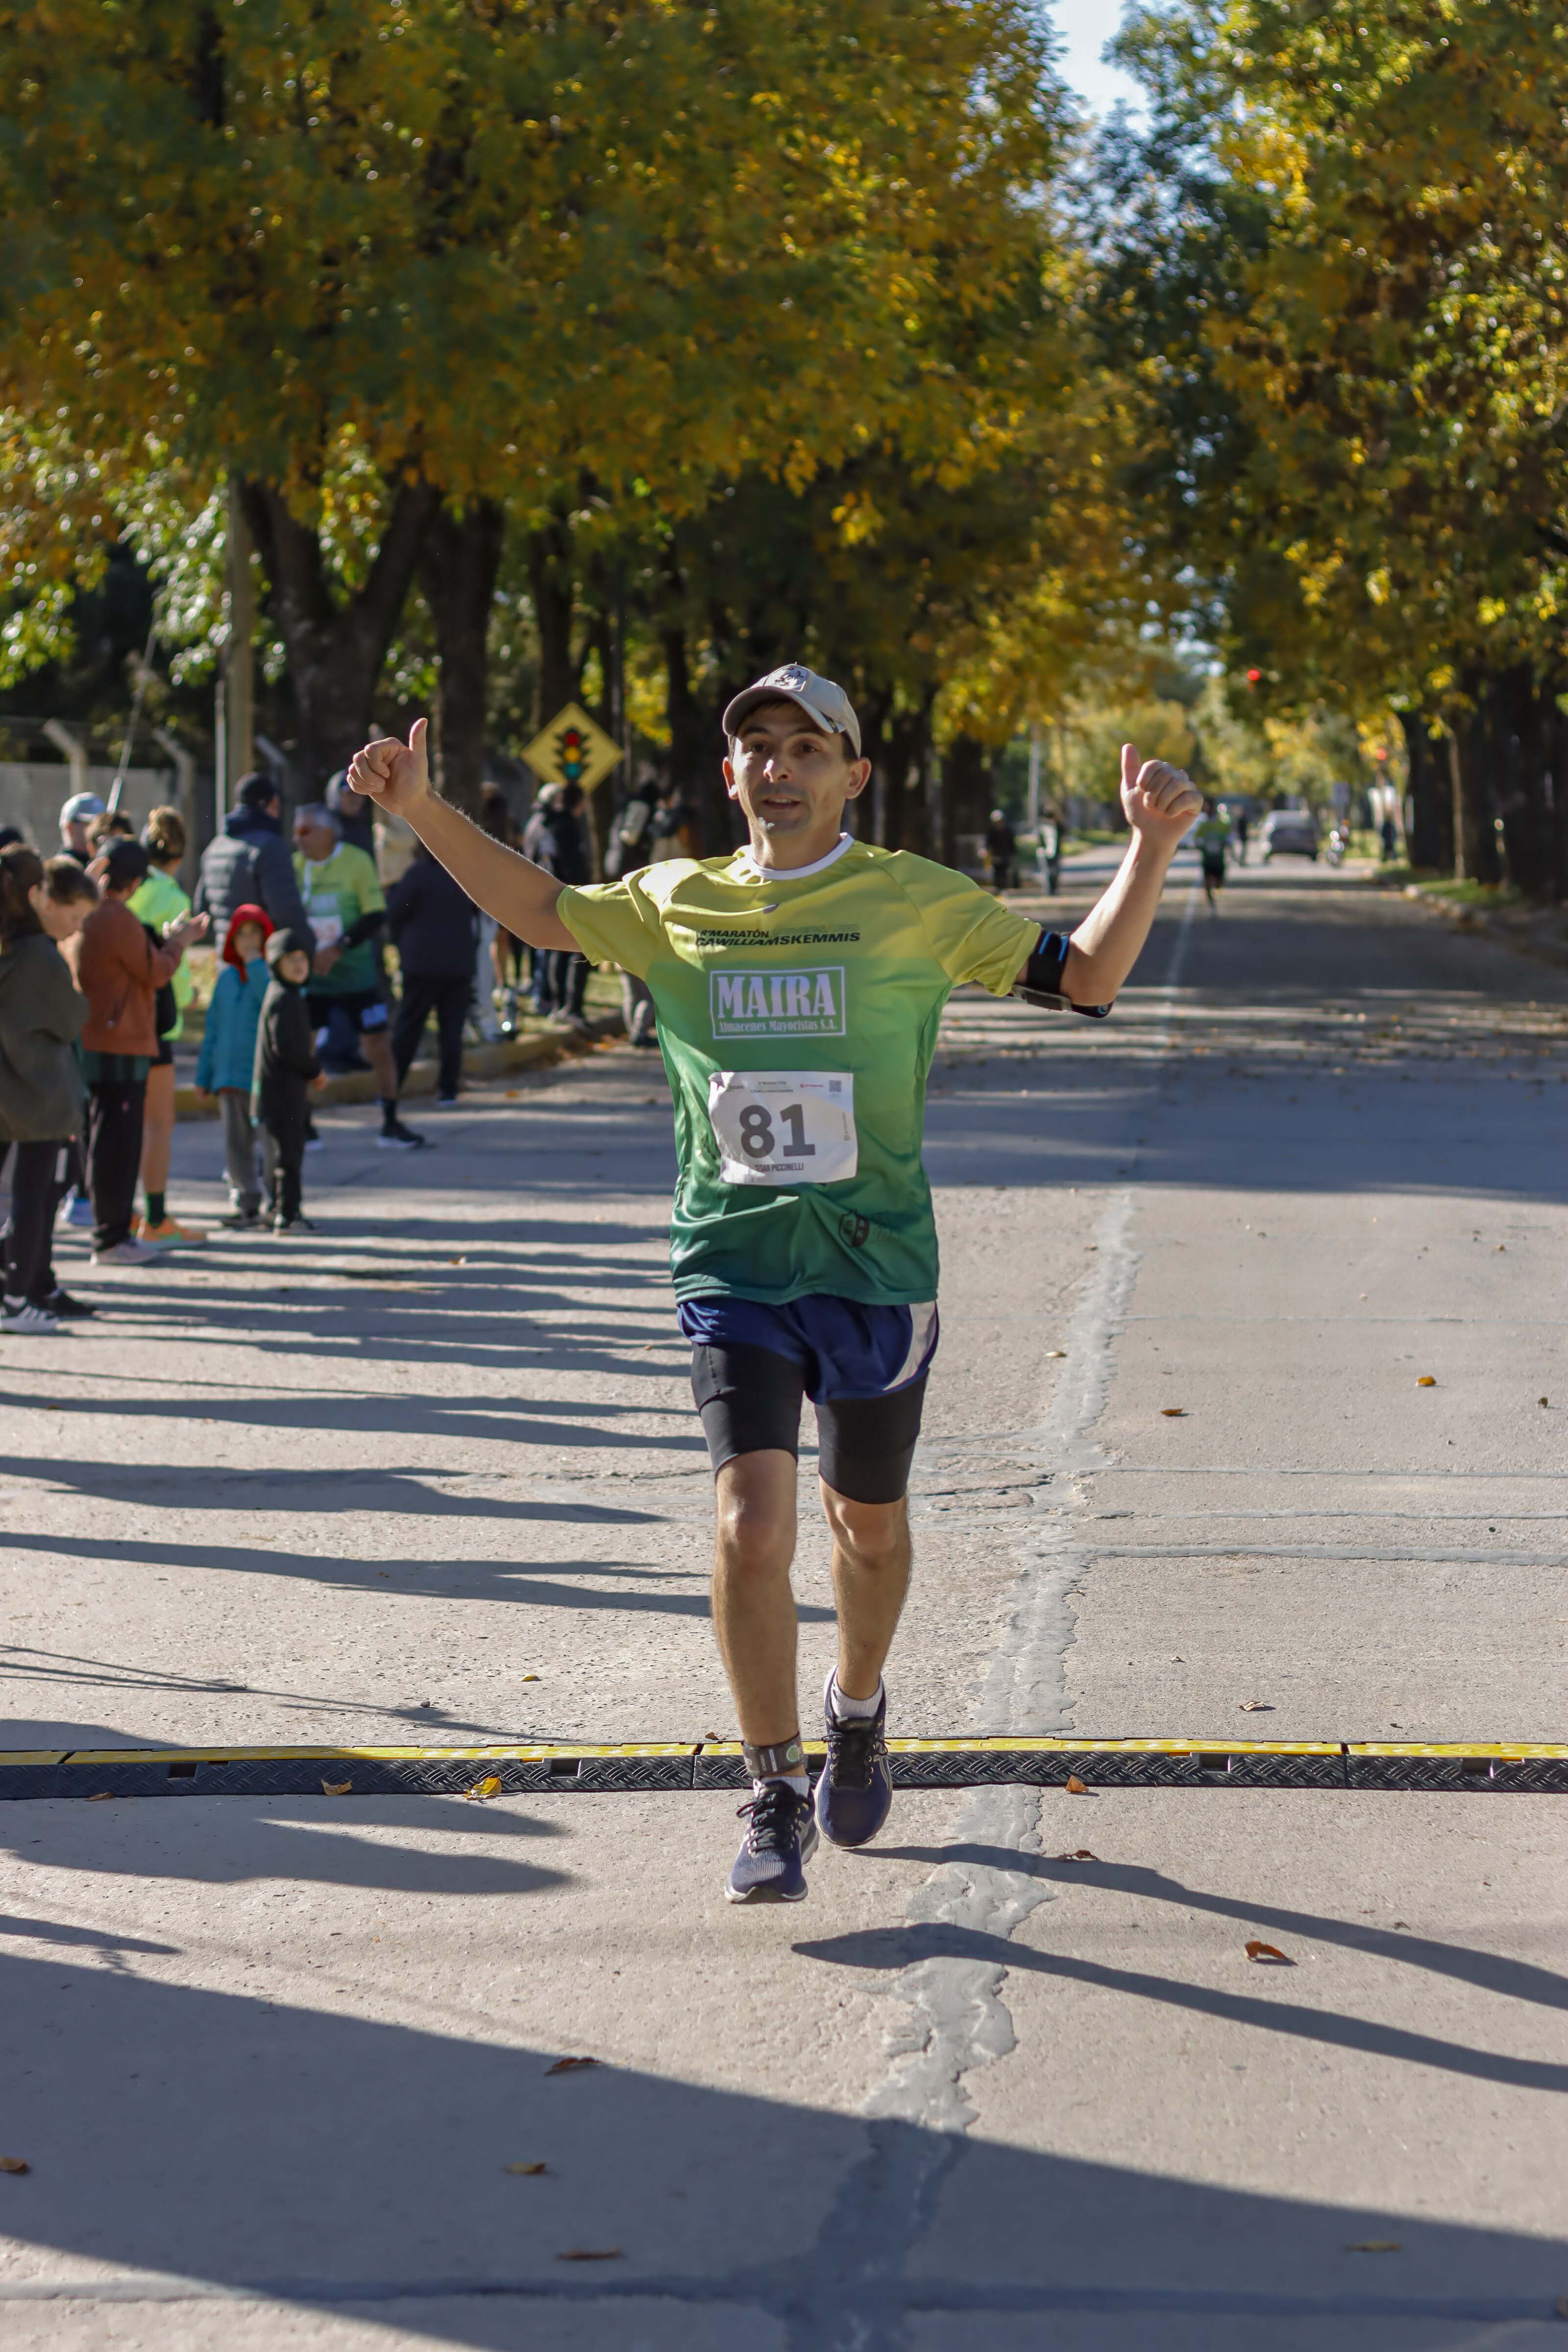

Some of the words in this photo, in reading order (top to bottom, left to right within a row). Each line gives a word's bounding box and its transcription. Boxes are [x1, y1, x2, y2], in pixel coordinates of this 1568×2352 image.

[717, 973, 836, 1018] MAIRA
[719, 1022, 765, 1032] Almacenes
[769, 1020, 818, 1032] Mayoristas
[739, 1103, 815, 1158] 81
